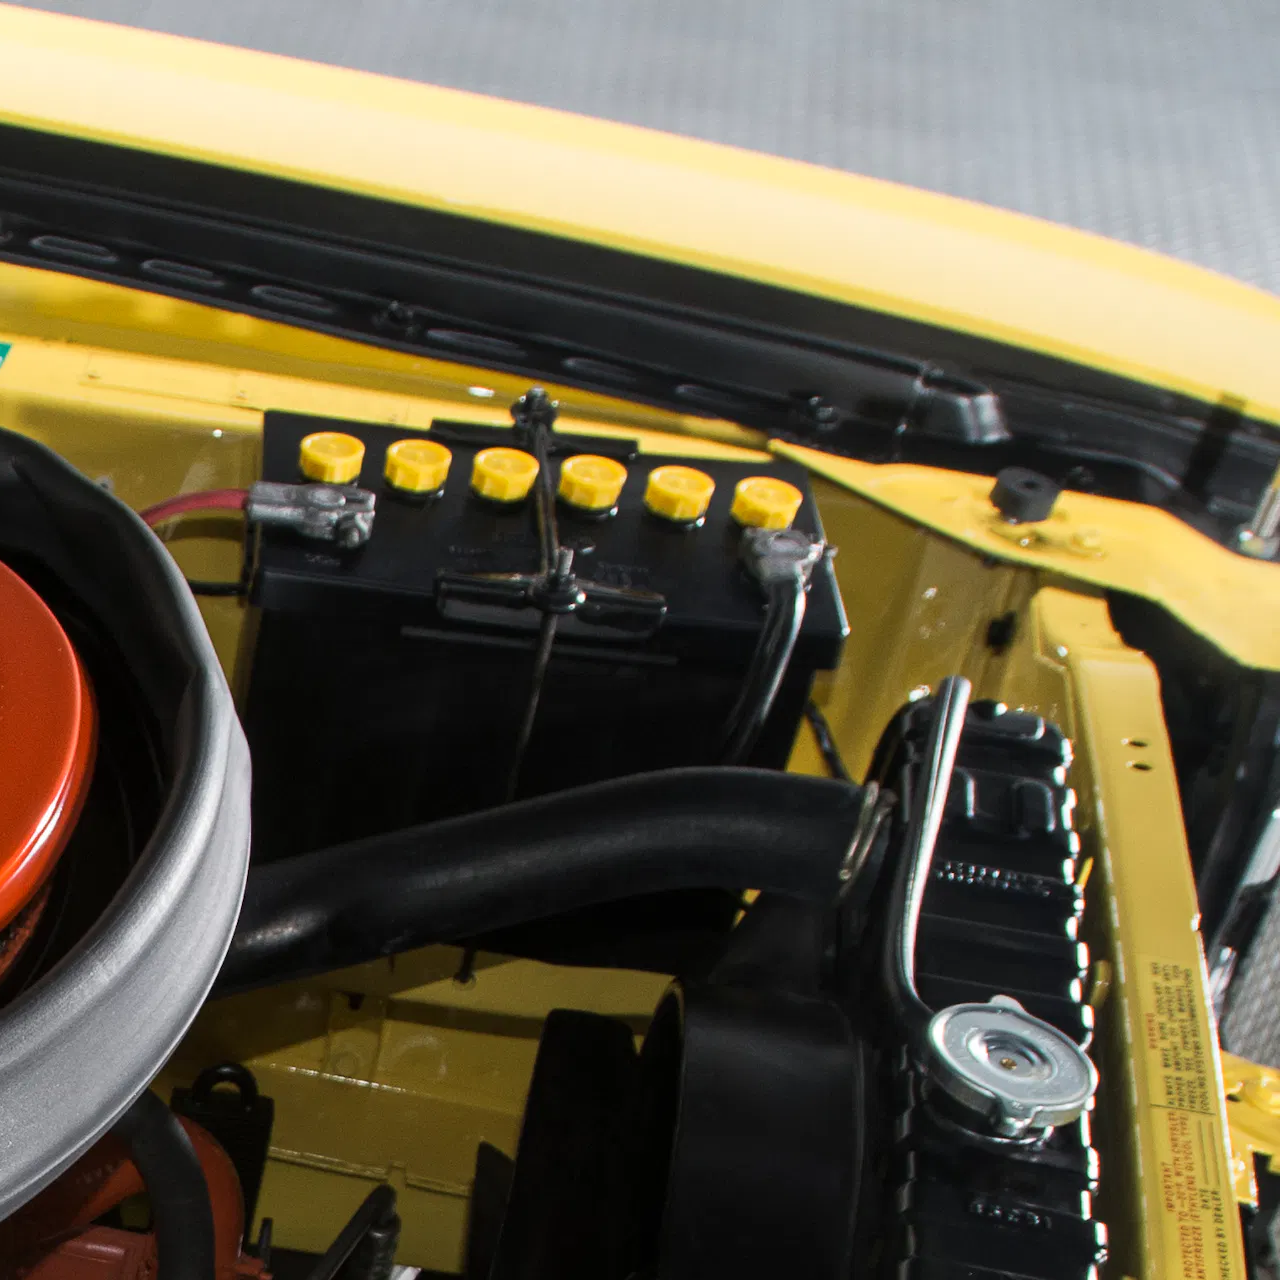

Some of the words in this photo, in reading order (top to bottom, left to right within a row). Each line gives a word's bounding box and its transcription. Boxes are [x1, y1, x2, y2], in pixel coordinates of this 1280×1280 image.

[1168, 1111, 1180, 1154] CHRYSLER
[1174, 1157, 1183, 1176] WITH
[1161, 1161, 1174, 1212] IMPORTANT
[1200, 1188, 1209, 1209] DATE
[1179, 1211, 1187, 1221] TO
[1212, 1190, 1223, 1223] DEALER
[1216, 1226, 1224, 1238] BY
[1179, 1225, 1192, 1278] PROTECTED
[1192, 1226, 1206, 1279] ANTIFREEZE
